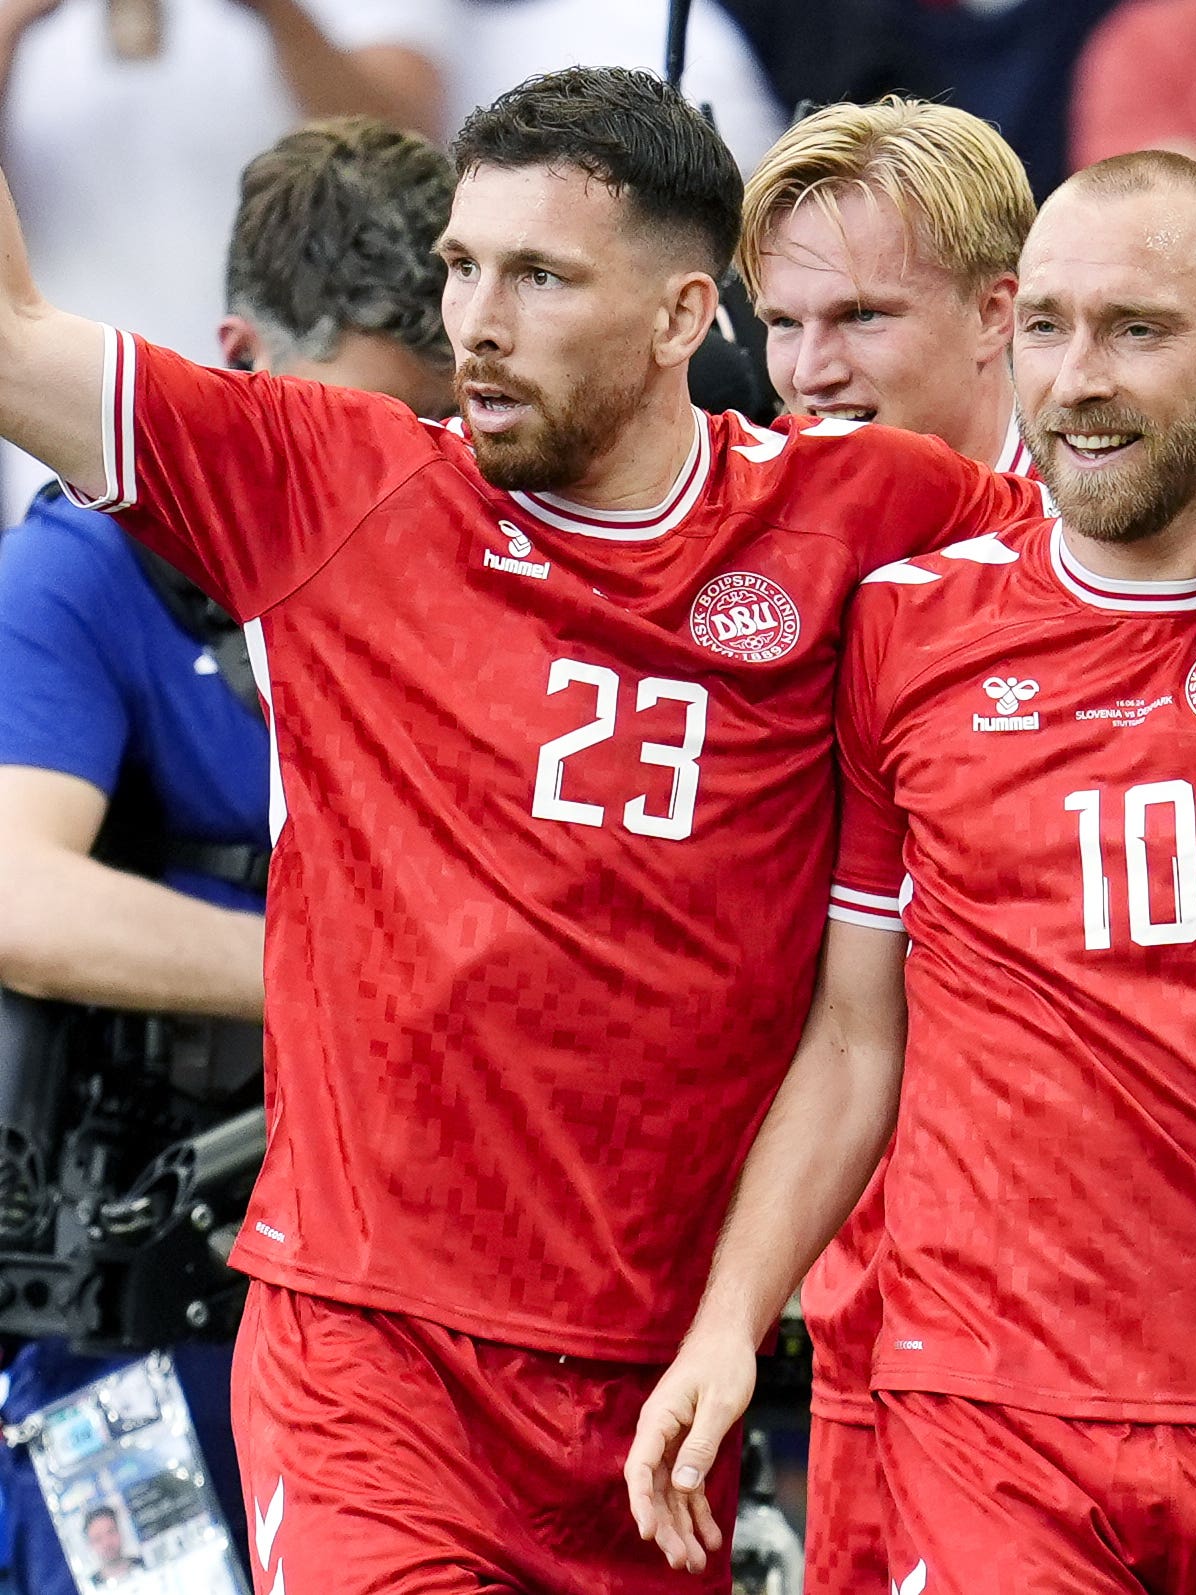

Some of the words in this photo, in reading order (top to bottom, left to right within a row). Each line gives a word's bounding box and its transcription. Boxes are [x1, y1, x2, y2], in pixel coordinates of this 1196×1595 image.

[483, 548, 551, 580] hummel
[710, 601, 779, 641] DBU
[773, 593, 795, 644] UNION
[972, 711, 1040, 732] hummel
[1075, 709, 1123, 721] SLOVENIA
[531, 657, 709, 841] 23
